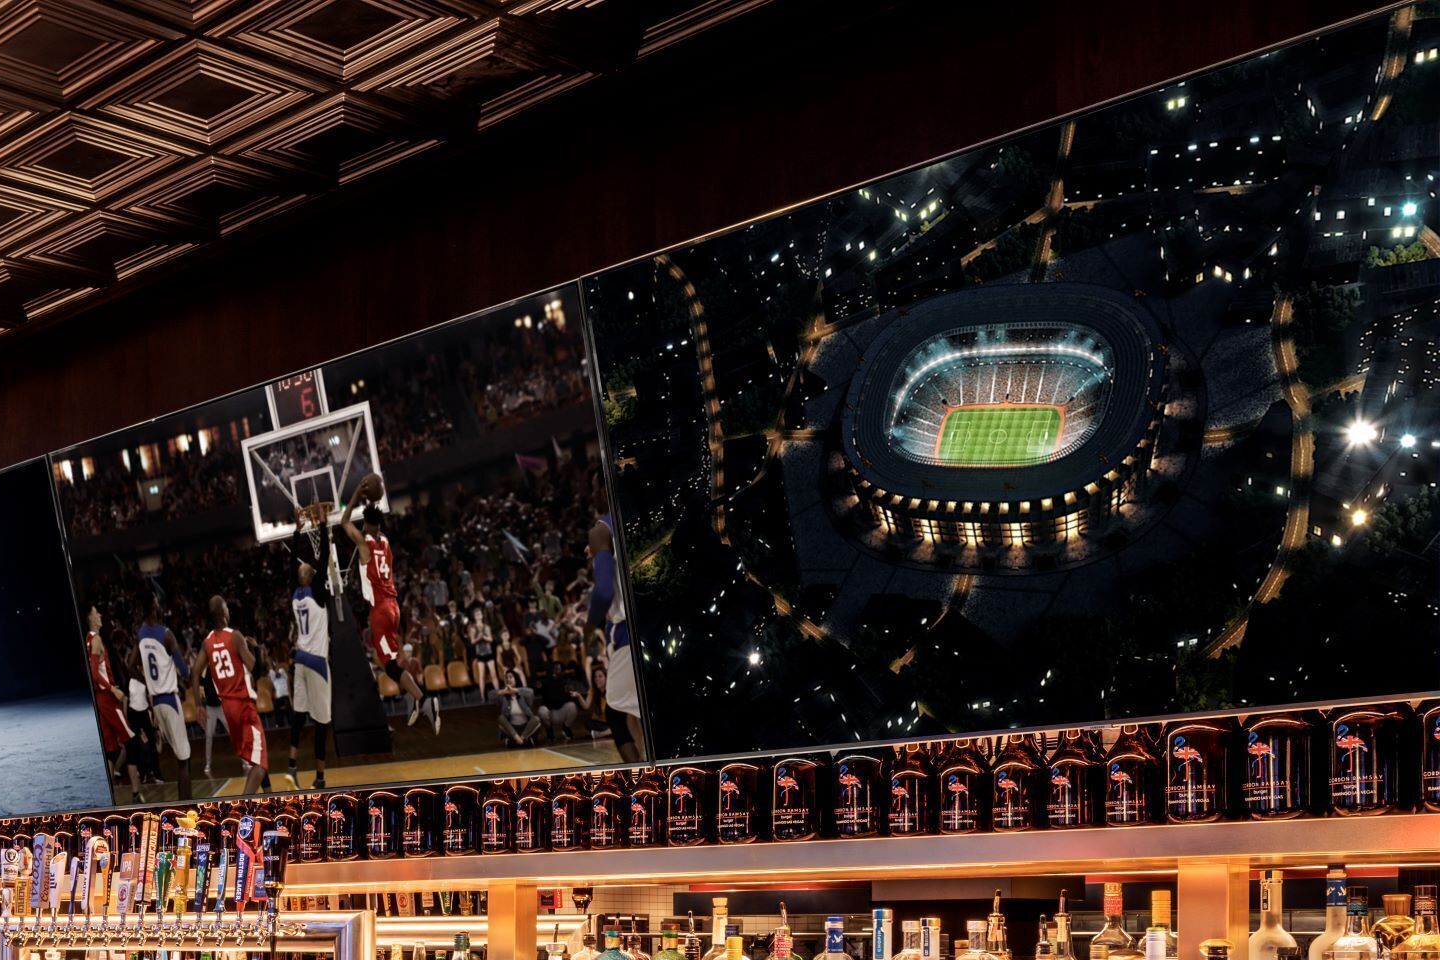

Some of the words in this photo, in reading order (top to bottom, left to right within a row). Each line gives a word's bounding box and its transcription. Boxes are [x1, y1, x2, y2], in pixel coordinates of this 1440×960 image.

[300, 386, 315, 418] 6
[374, 554, 391, 580] 14
[297, 608, 310, 636] 17
[148, 652, 159, 681] 6
[212, 648, 235, 680] 23
[122, 860, 132, 872] IPA
[238, 853, 246, 878] BOSTON
